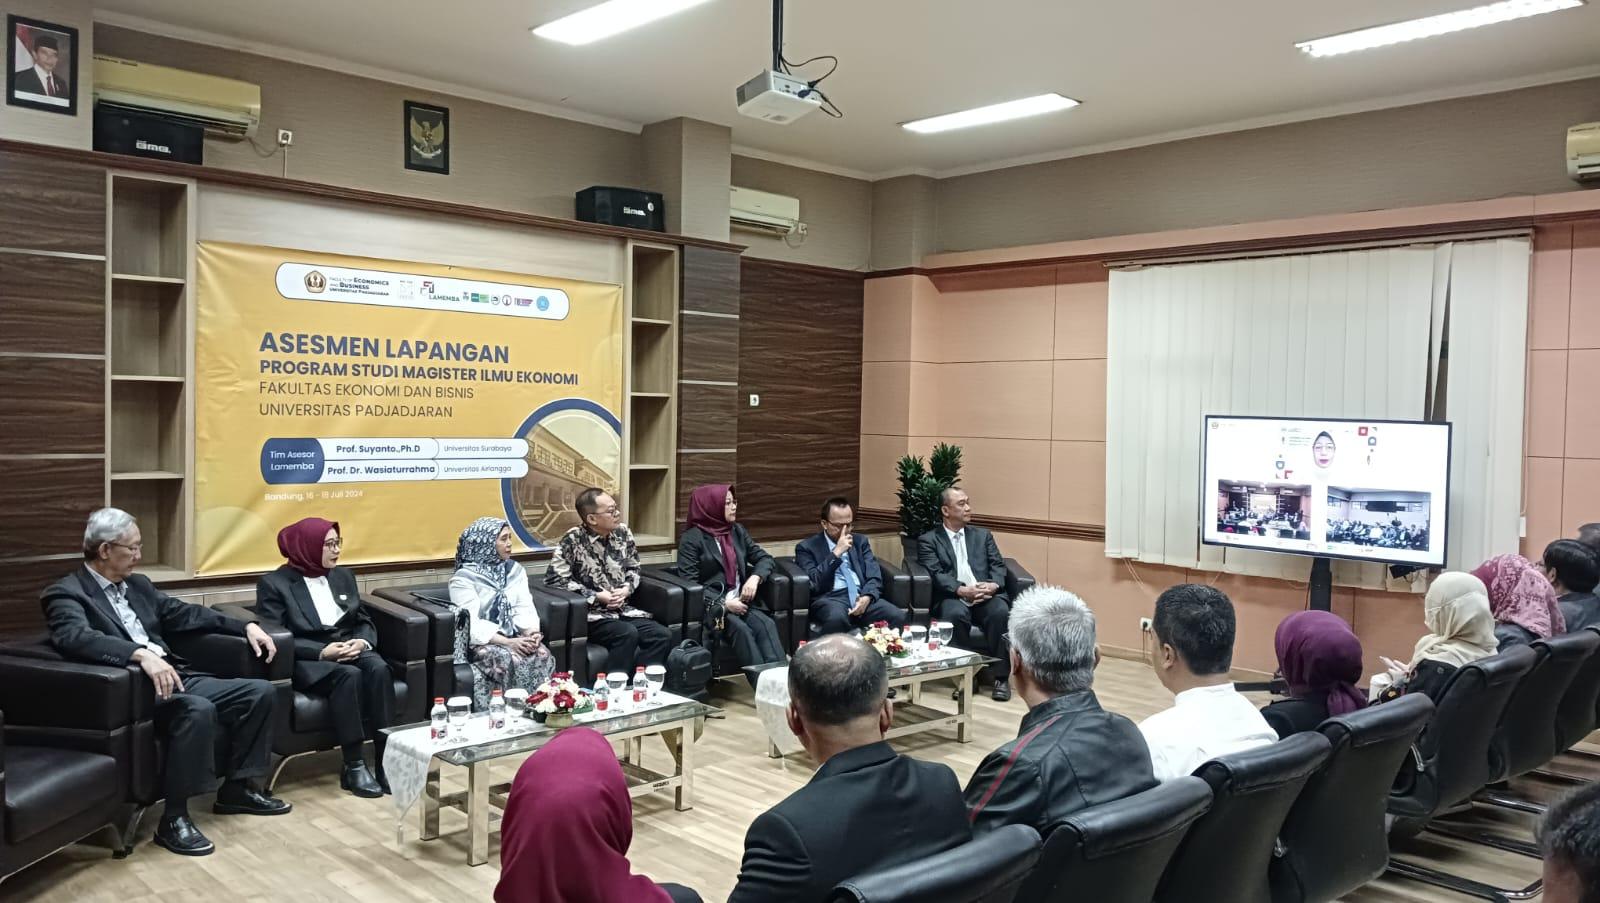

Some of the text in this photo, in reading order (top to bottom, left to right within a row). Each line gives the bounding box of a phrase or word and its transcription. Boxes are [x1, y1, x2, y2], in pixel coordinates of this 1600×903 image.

[354, 277, 389, 286] ECONOMICS
[259, 332, 509, 364] ASESMEN LAPANGAN
[260, 360, 578, 385] PROGRAM STUDI MAGISTER ILMU EKONOMI
[260, 381, 474, 398] FAKULTAS EKONOMI DAN BISNIS
[260, 403, 453, 418] UNIVERSITAS PADJADJARAN
[336, 445, 357, 453] Prof.
[481, 445, 512, 453] Surabaya
[270, 450, 315, 459] Tim Asesor
[270, 462, 315, 471] Lamemba
[327, 467, 348, 475] Prof.
[365, 465, 435, 474] Wasiaturrahma
[481, 465, 512, 474] Airlangga
[264, 492, 304, 502] Bandung,
[331, 490, 343, 498] Juli
[345, 490, 363, 498] 2024
